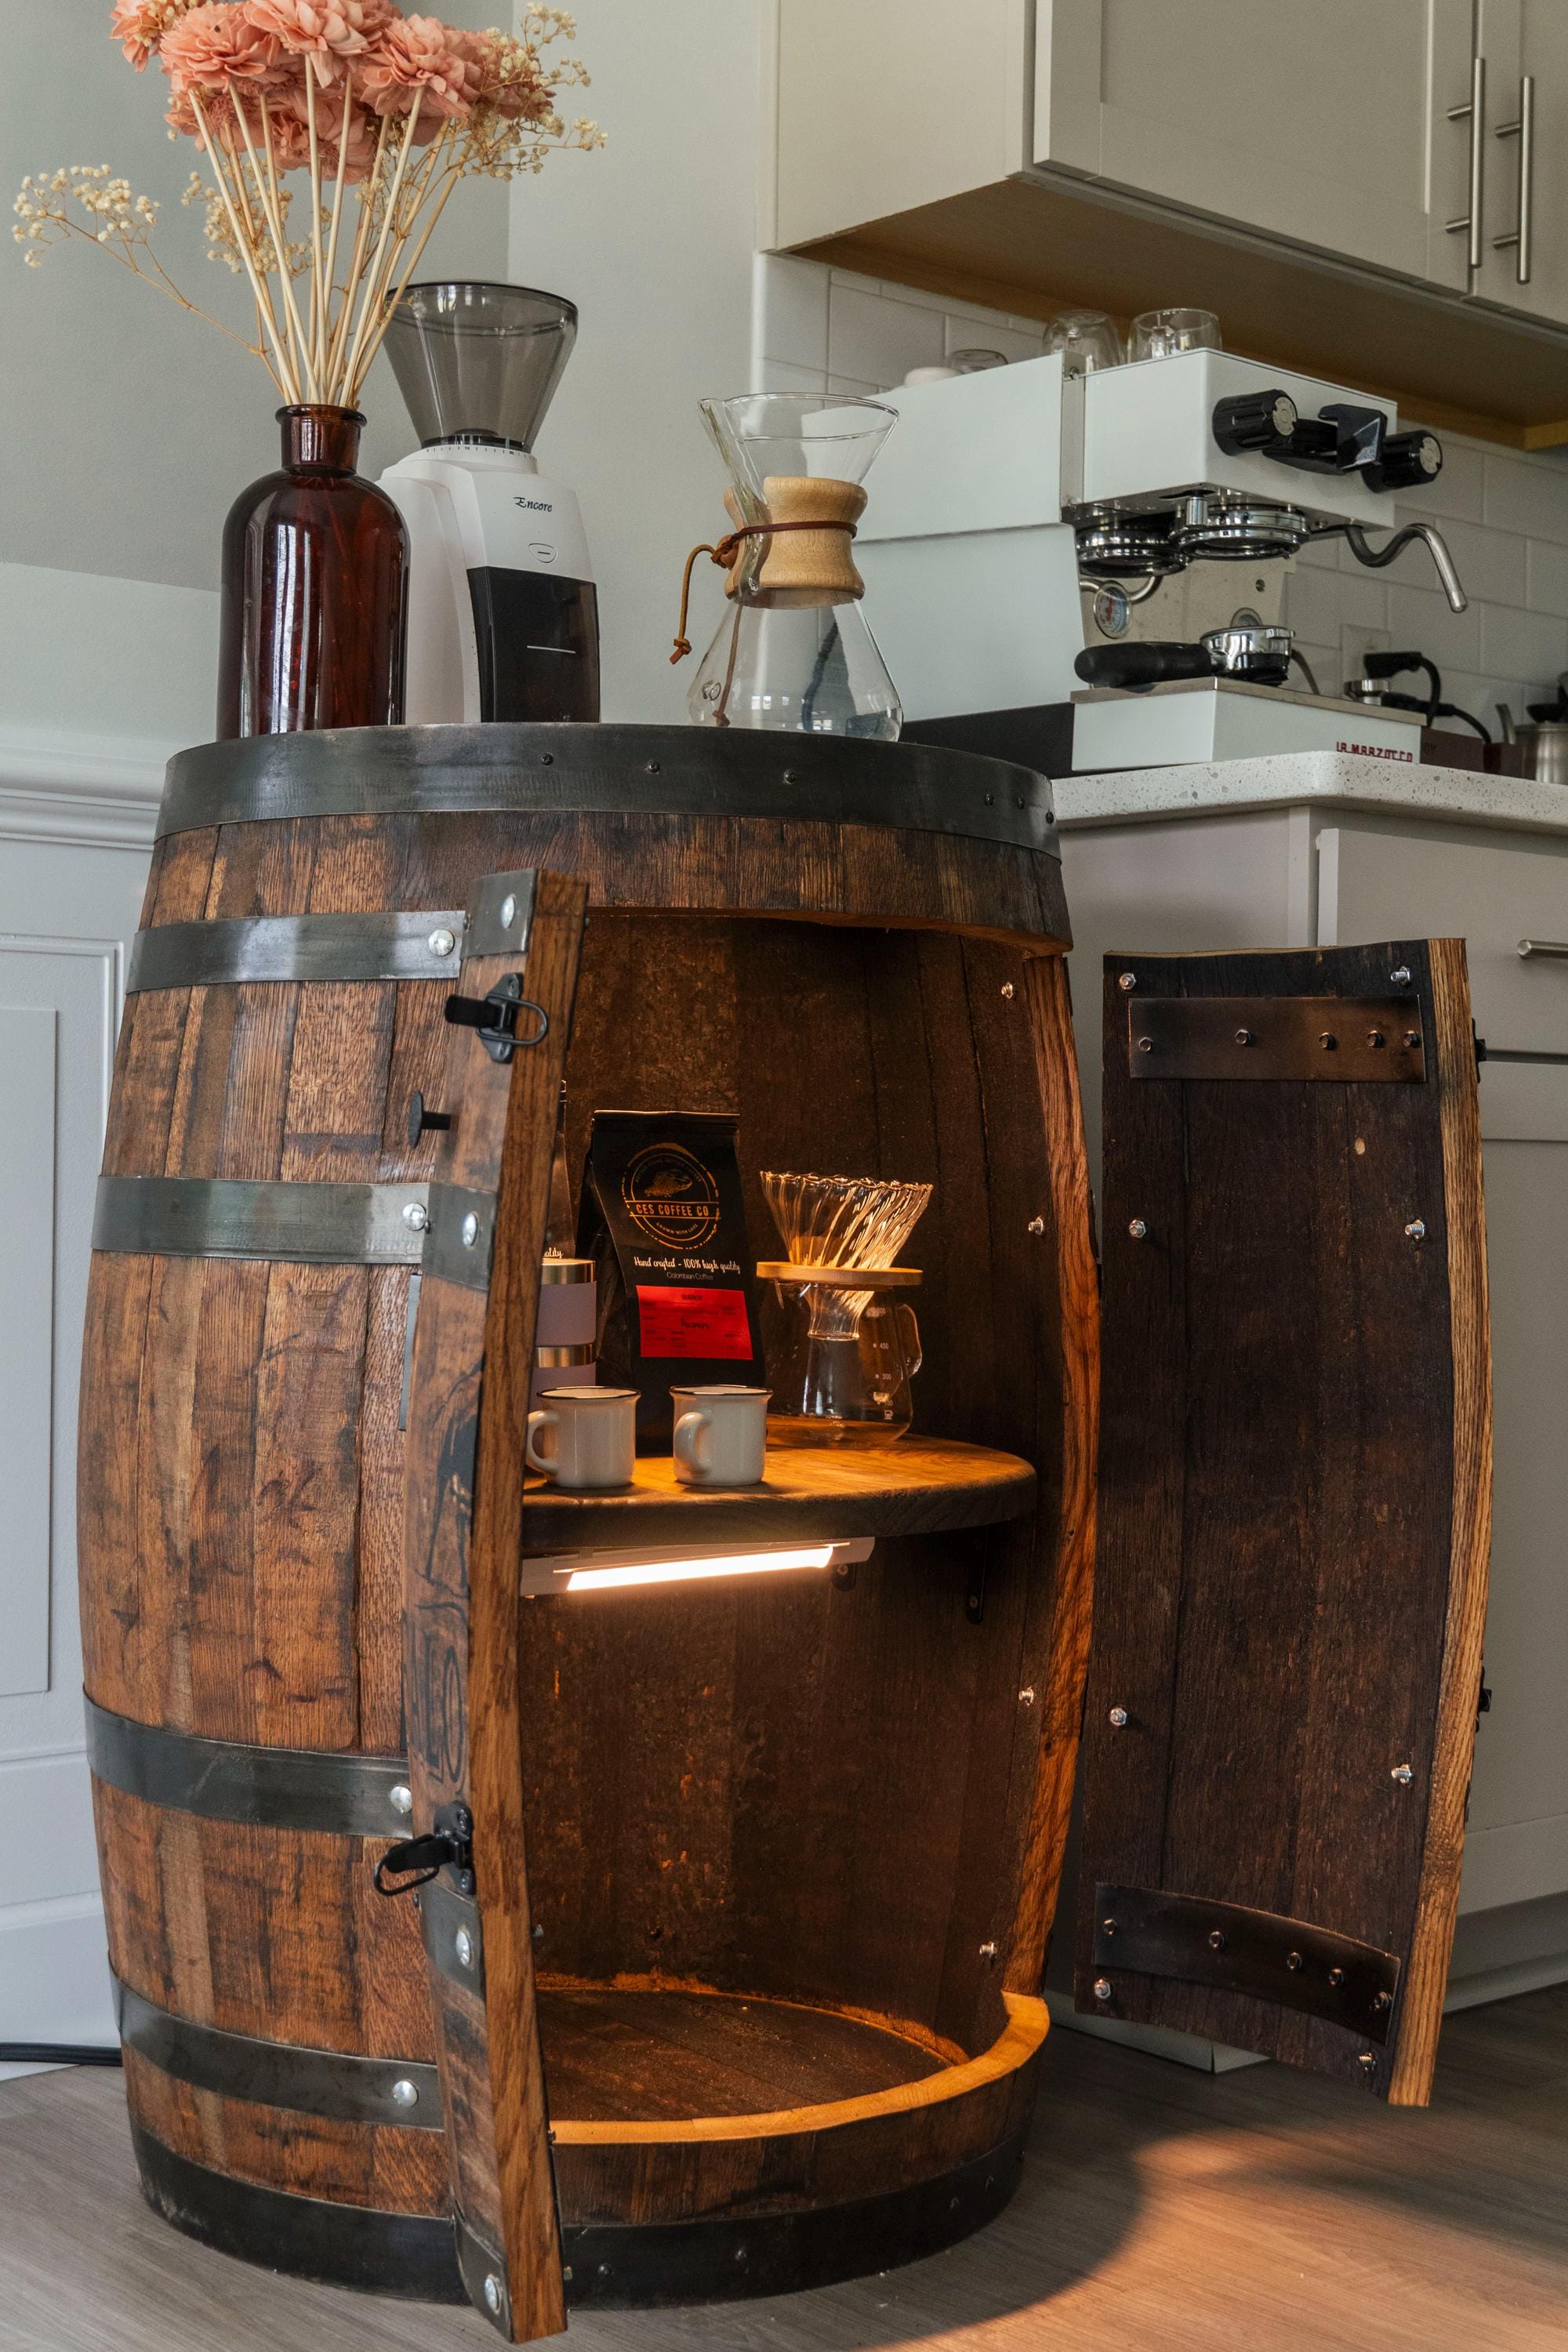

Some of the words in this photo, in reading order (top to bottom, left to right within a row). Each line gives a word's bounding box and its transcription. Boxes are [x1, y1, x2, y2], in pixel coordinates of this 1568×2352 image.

[514, 496, 553, 512] Encore
[636, 1203, 655, 1214] CES
[659, 1203, 693, 1216] COFFEE
[696, 1205, 709, 1216] CO
[633, 1256, 652, 1267] Hand
[653, 1257, 676, 1271] crafted
[684, 1258, 701, 1269] 100%
[702, 1259, 719, 1272] high
[720, 1260, 740, 1275] quality
